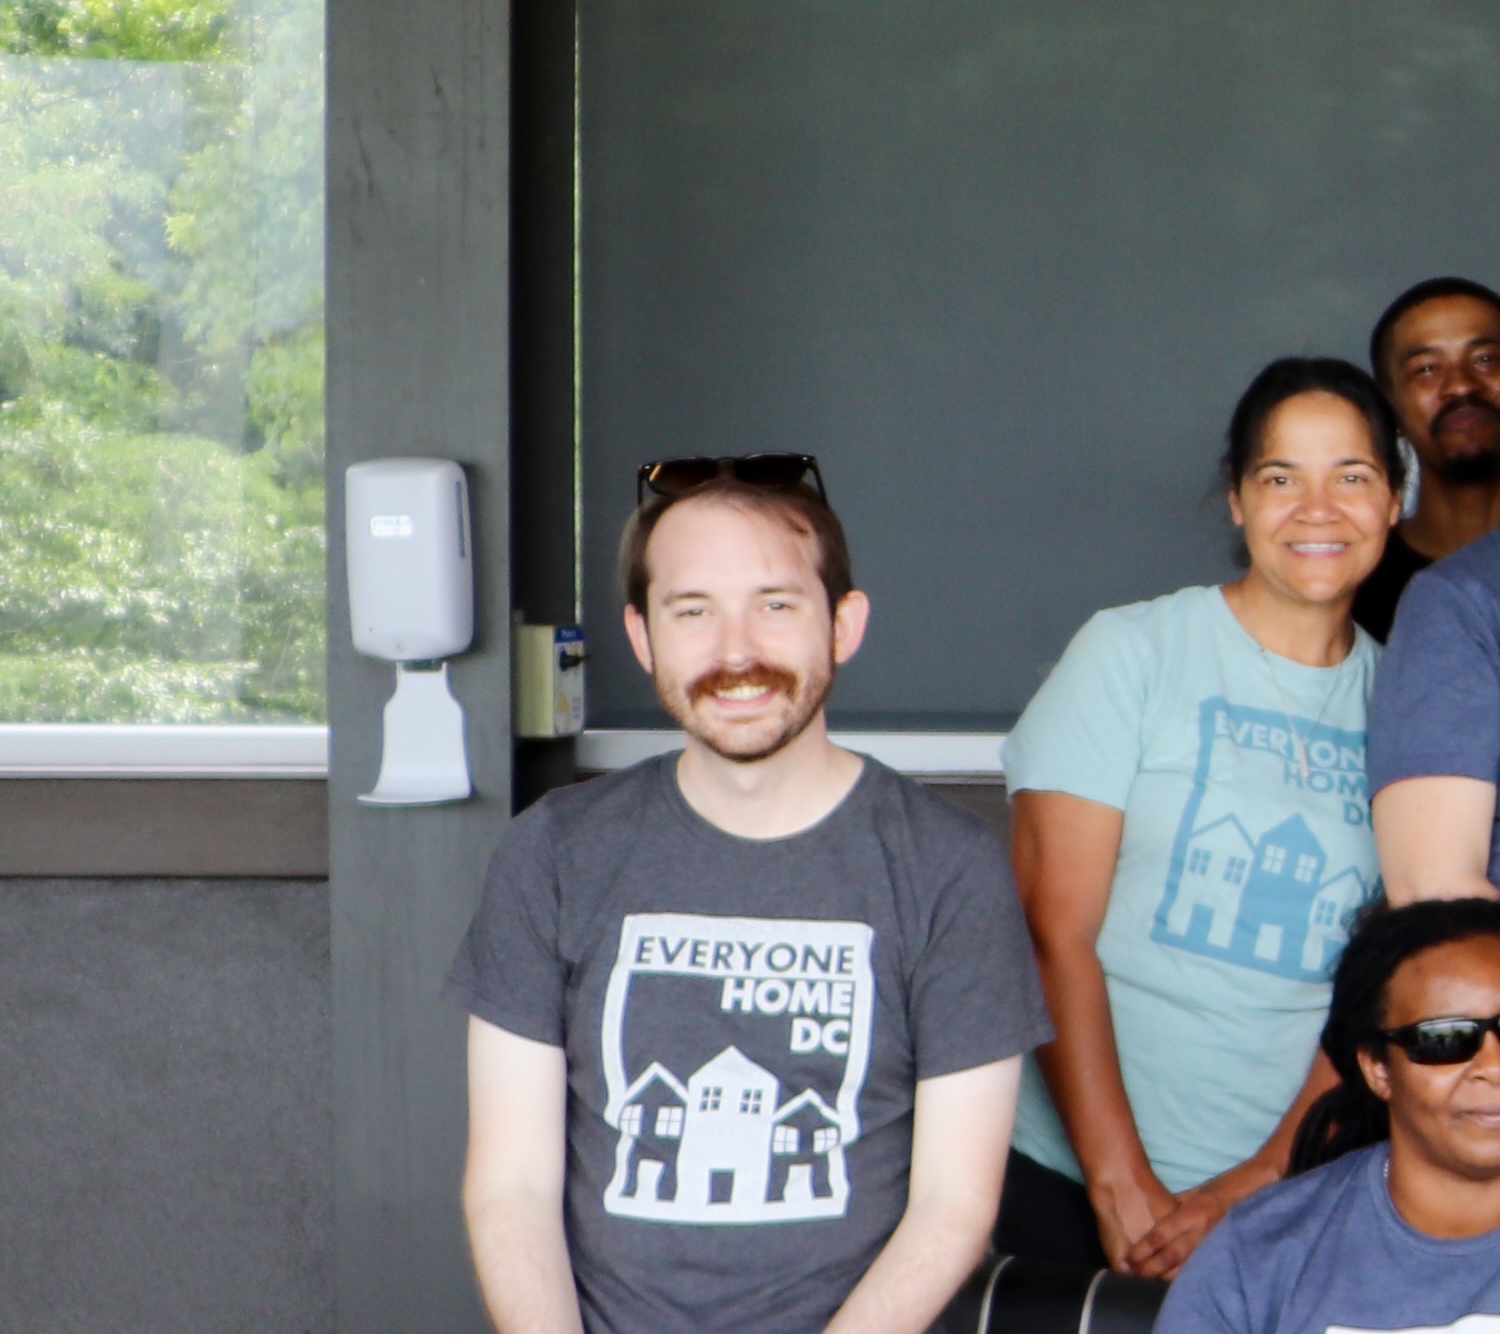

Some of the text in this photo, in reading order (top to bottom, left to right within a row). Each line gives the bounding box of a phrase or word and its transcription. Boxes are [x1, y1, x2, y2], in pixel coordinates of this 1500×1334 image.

[1344, 800, 1372, 828] D
[634, 935, 855, 976] EVERYONE
[721, 977, 853, 1017] HOME
[790, 1018, 851, 1056] DC
